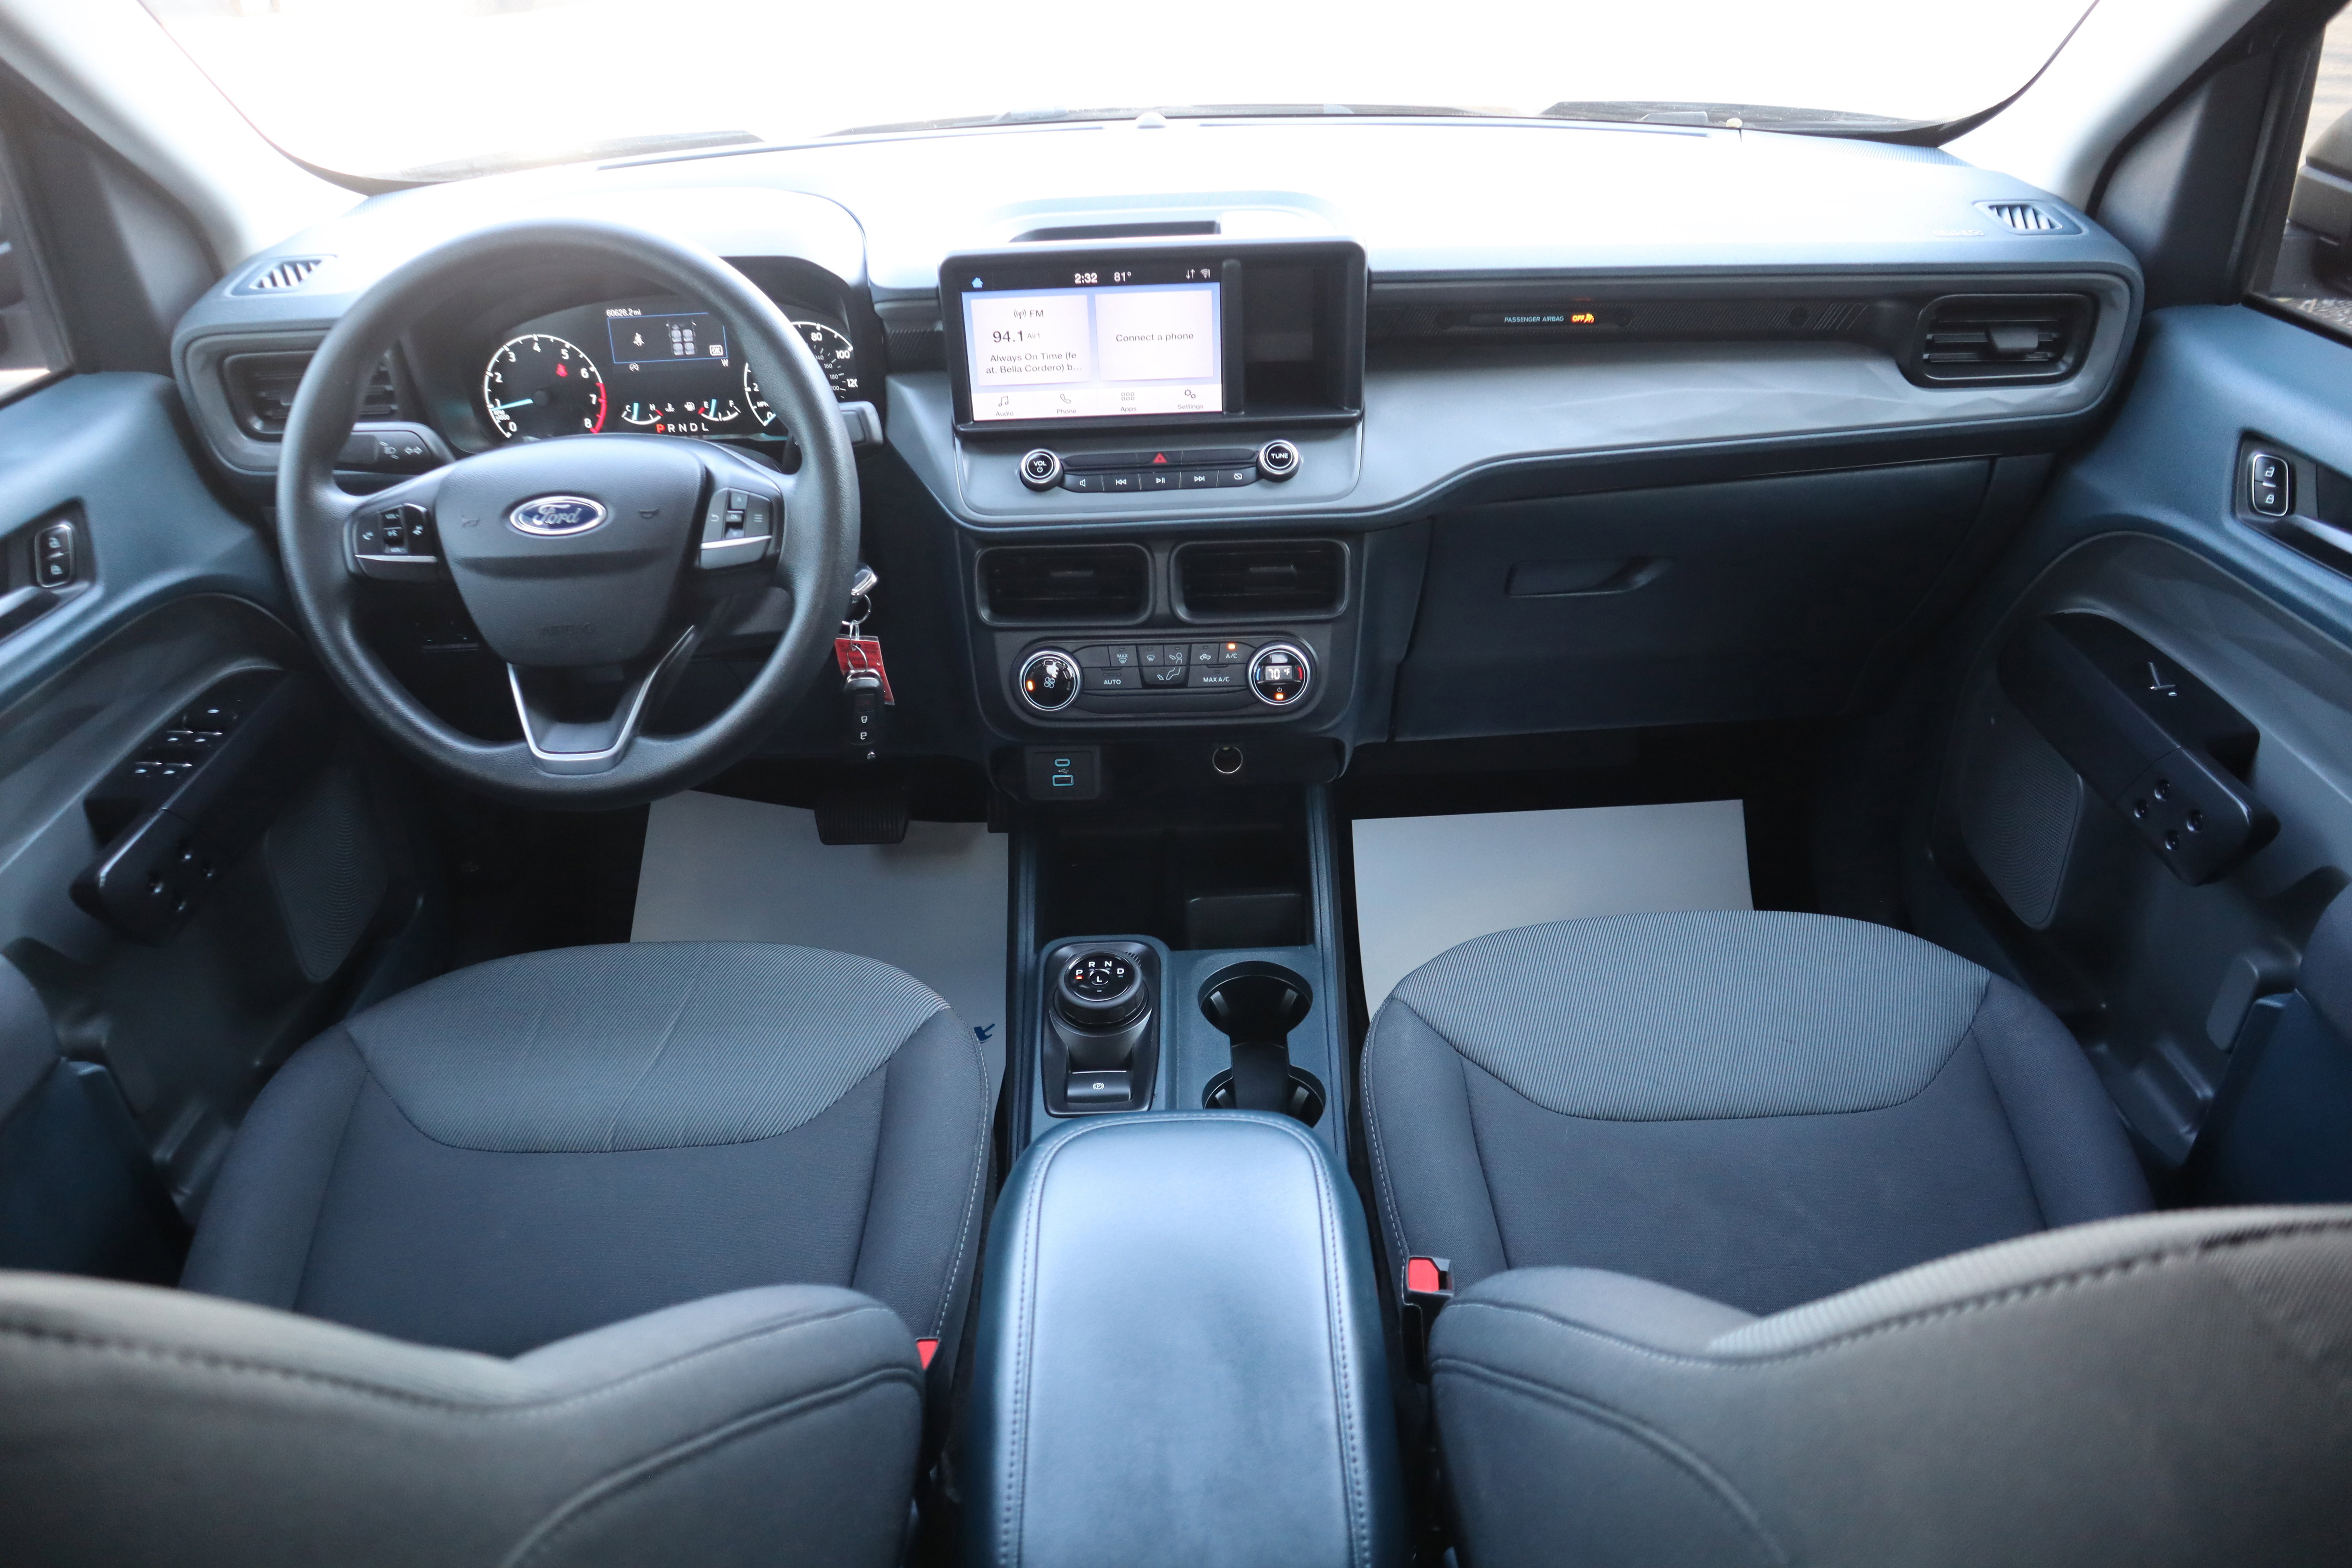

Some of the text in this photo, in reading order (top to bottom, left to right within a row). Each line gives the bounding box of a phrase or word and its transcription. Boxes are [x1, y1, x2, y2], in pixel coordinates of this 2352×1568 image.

[1074, 272, 1098, 284] 2:32
[811, 332, 822, 341] 80
[993, 330, 1023, 343] 94.1
[1116, 333, 1154, 342] Connect
[1165, 332, 1194, 341] phone
[533, 342, 541, 353] 4
[508, 352, 516, 362] 3
[561, 349, 569, 360] 5
[835, 350, 850, 359] 100
[990, 354, 1022, 363] Always
[1040, 352, 1062, 360] Time
[1065, 351, 1076, 361] (fe
[581, 368, 589, 379] 6
[1025, 363, 1064, 373] Cordero)
[494, 372, 503, 383] 2
[753, 383, 759, 392] 2
[589, 394, 597, 405] 7
[509, 422, 517, 432] 0
[584, 418, 592, 428] 8
[656, 422, 709, 434] P R N D L
[532, 504, 583, 526] Ford
[1268, 668, 1280, 680] 70
